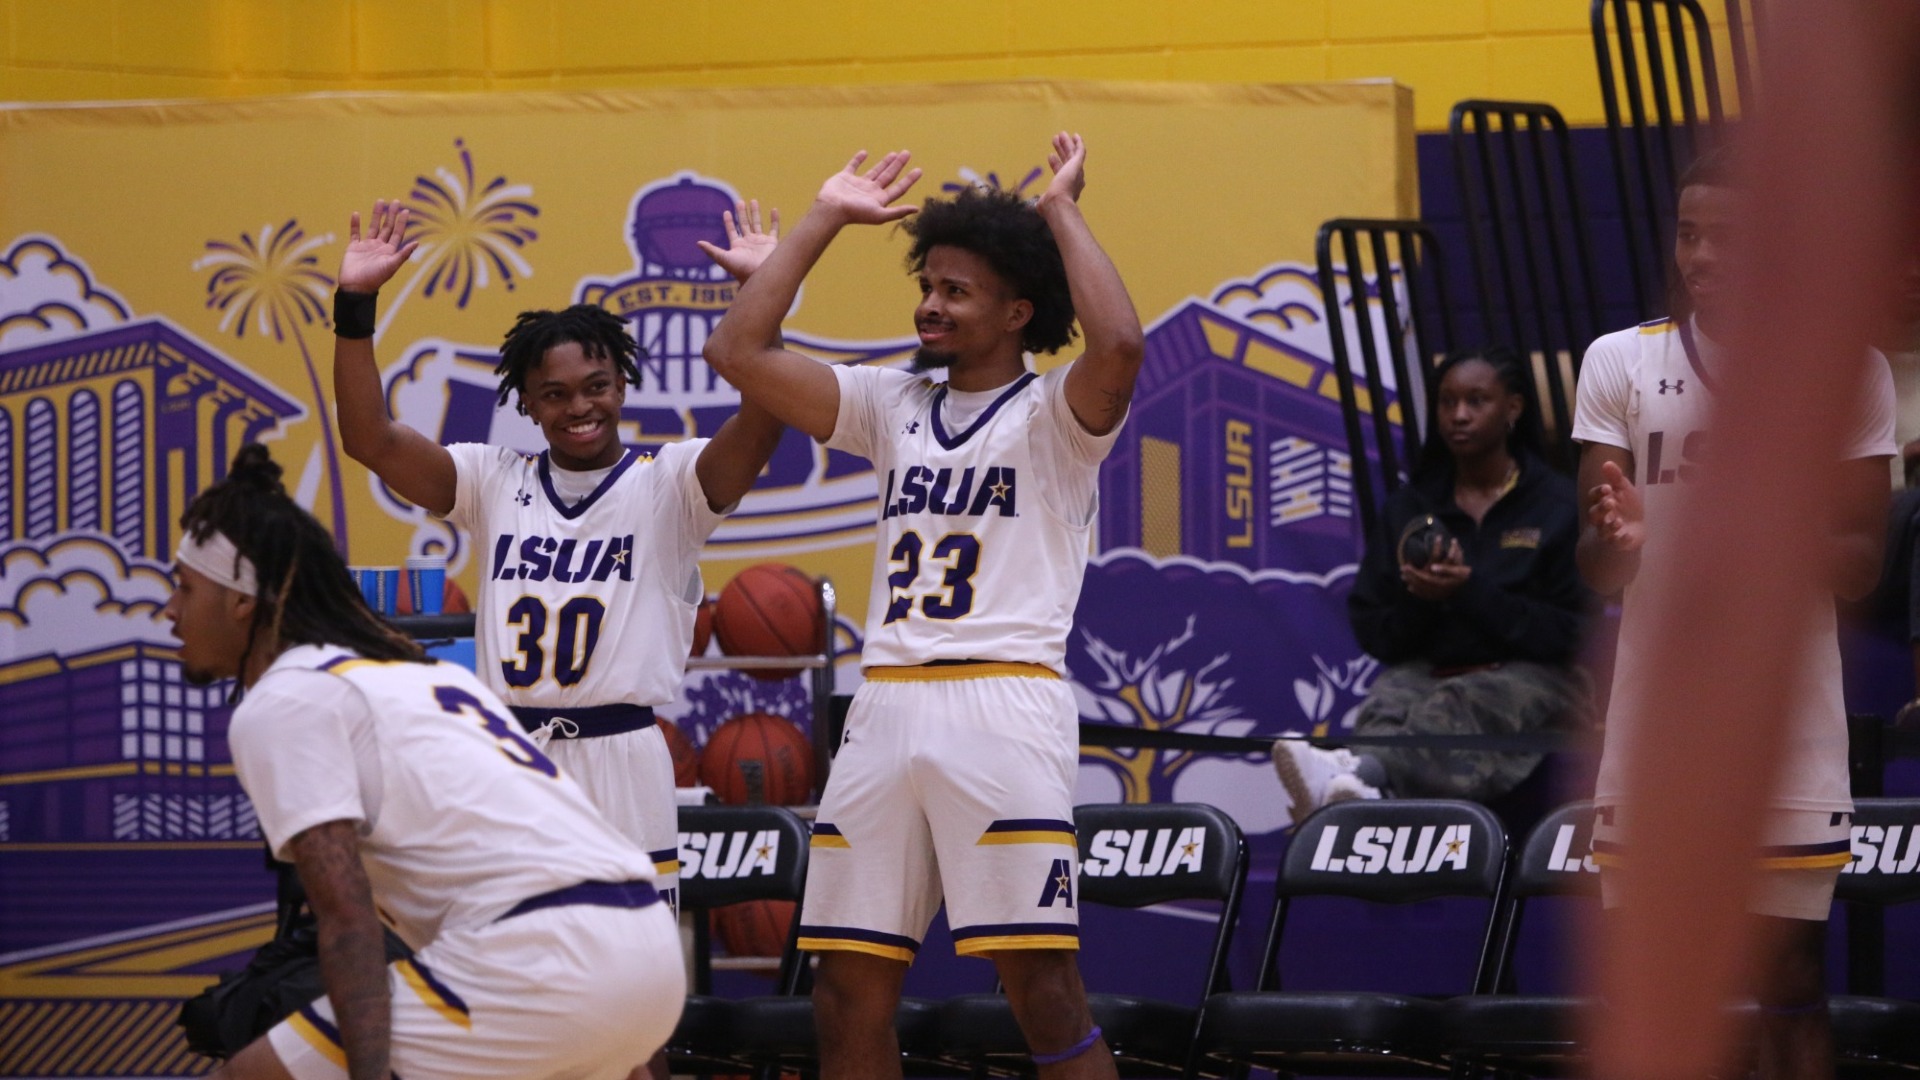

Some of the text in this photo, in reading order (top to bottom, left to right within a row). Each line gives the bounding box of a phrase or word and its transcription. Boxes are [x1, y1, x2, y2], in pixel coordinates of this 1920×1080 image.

[617, 285, 740, 310] EST. 196
[882, 465, 1019, 521] LSUA
[1226, 419, 1253, 548] LSUA
[491, 534, 635, 584] LSUA
[881, 528, 983, 628] 23
[501, 594, 607, 690] 30
[431, 684, 559, 779] 3
[677, 829, 780, 880] SUA
[1078, 826, 1206, 877] SUA
[1310, 824, 1472, 874] LSUA
[1841, 824, 1920, 875] SU
